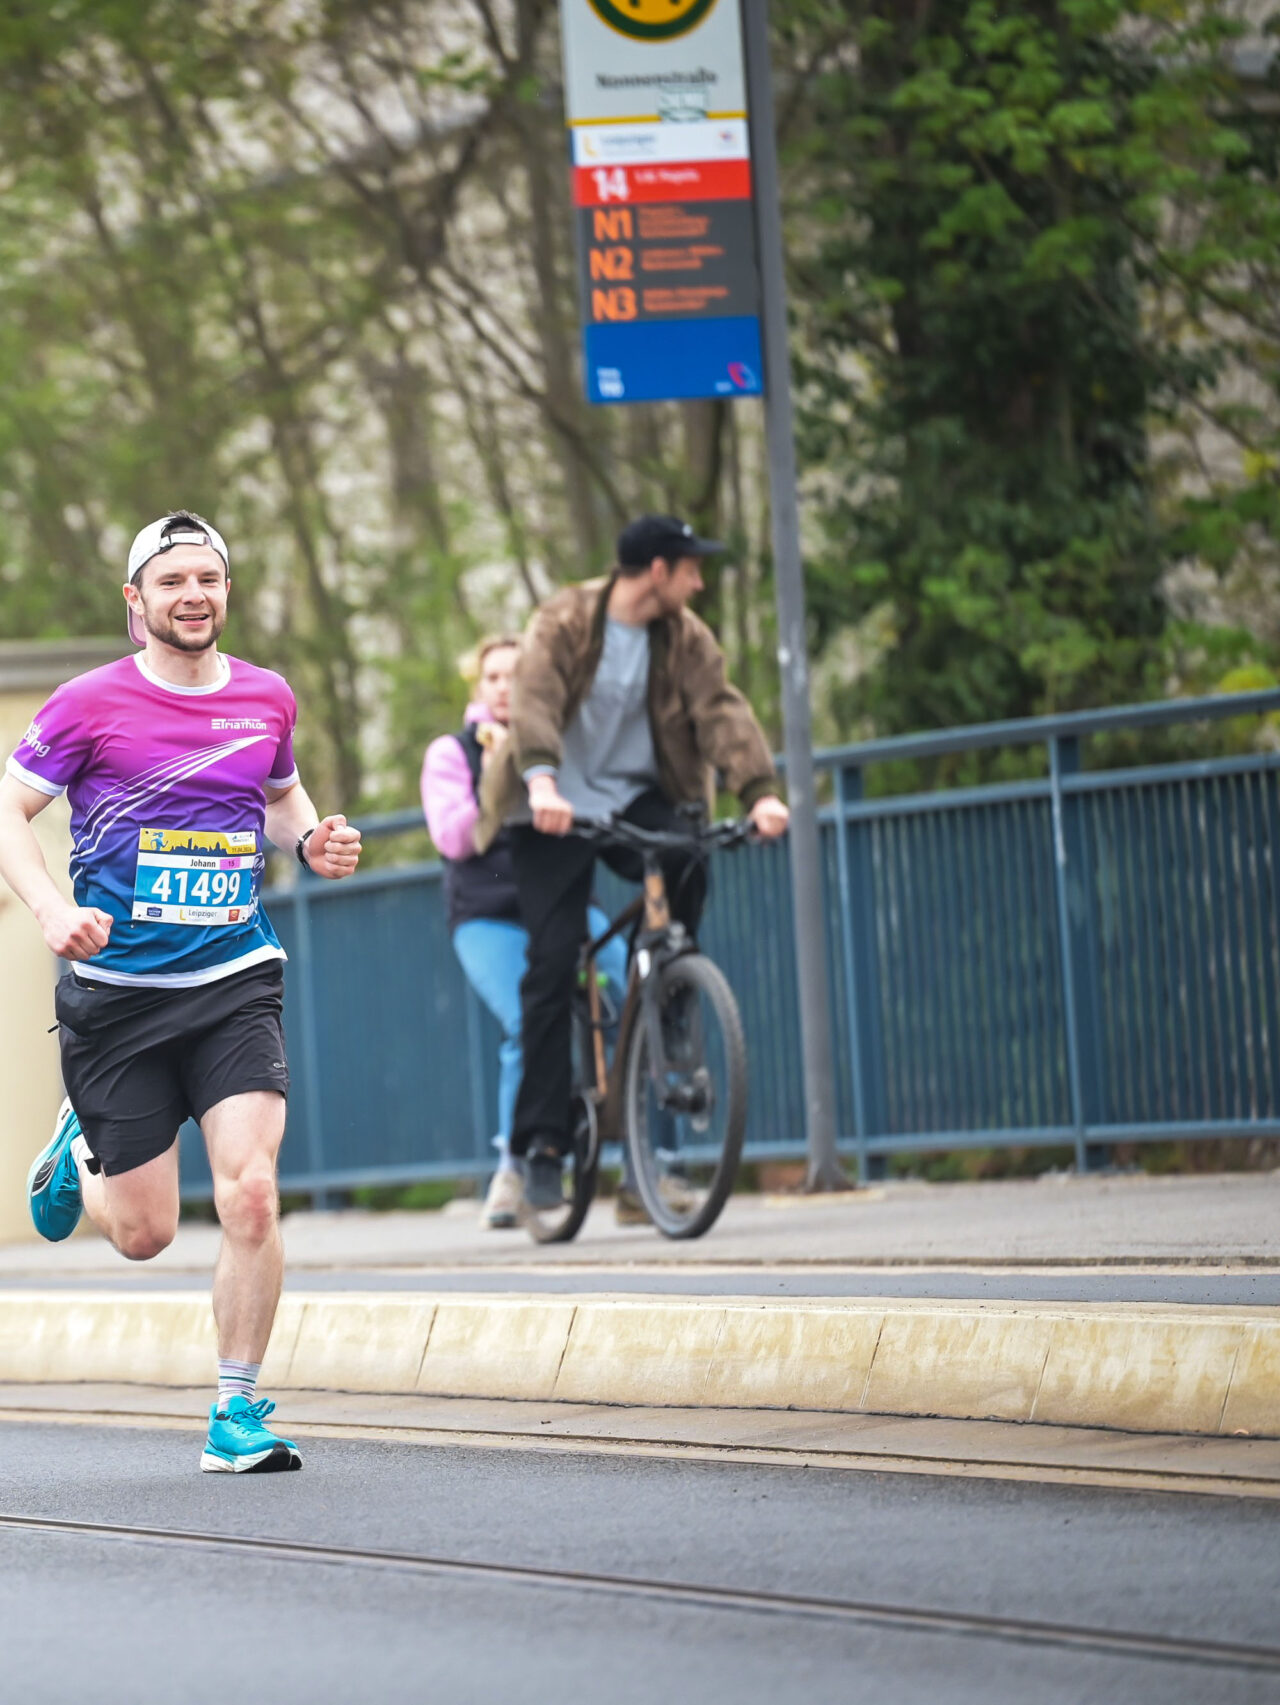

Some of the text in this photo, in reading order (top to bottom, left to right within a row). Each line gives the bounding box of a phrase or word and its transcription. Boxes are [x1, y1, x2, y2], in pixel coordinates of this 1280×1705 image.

[592, 167, 629, 201] 14
[593, 209, 633, 241] N1
[589, 246, 634, 280] N2
[592, 286, 637, 321] N3
[190, 859, 216, 868] Johann
[151, 870, 241, 905] 41499
[188, 908, 218, 918] Leipziger
